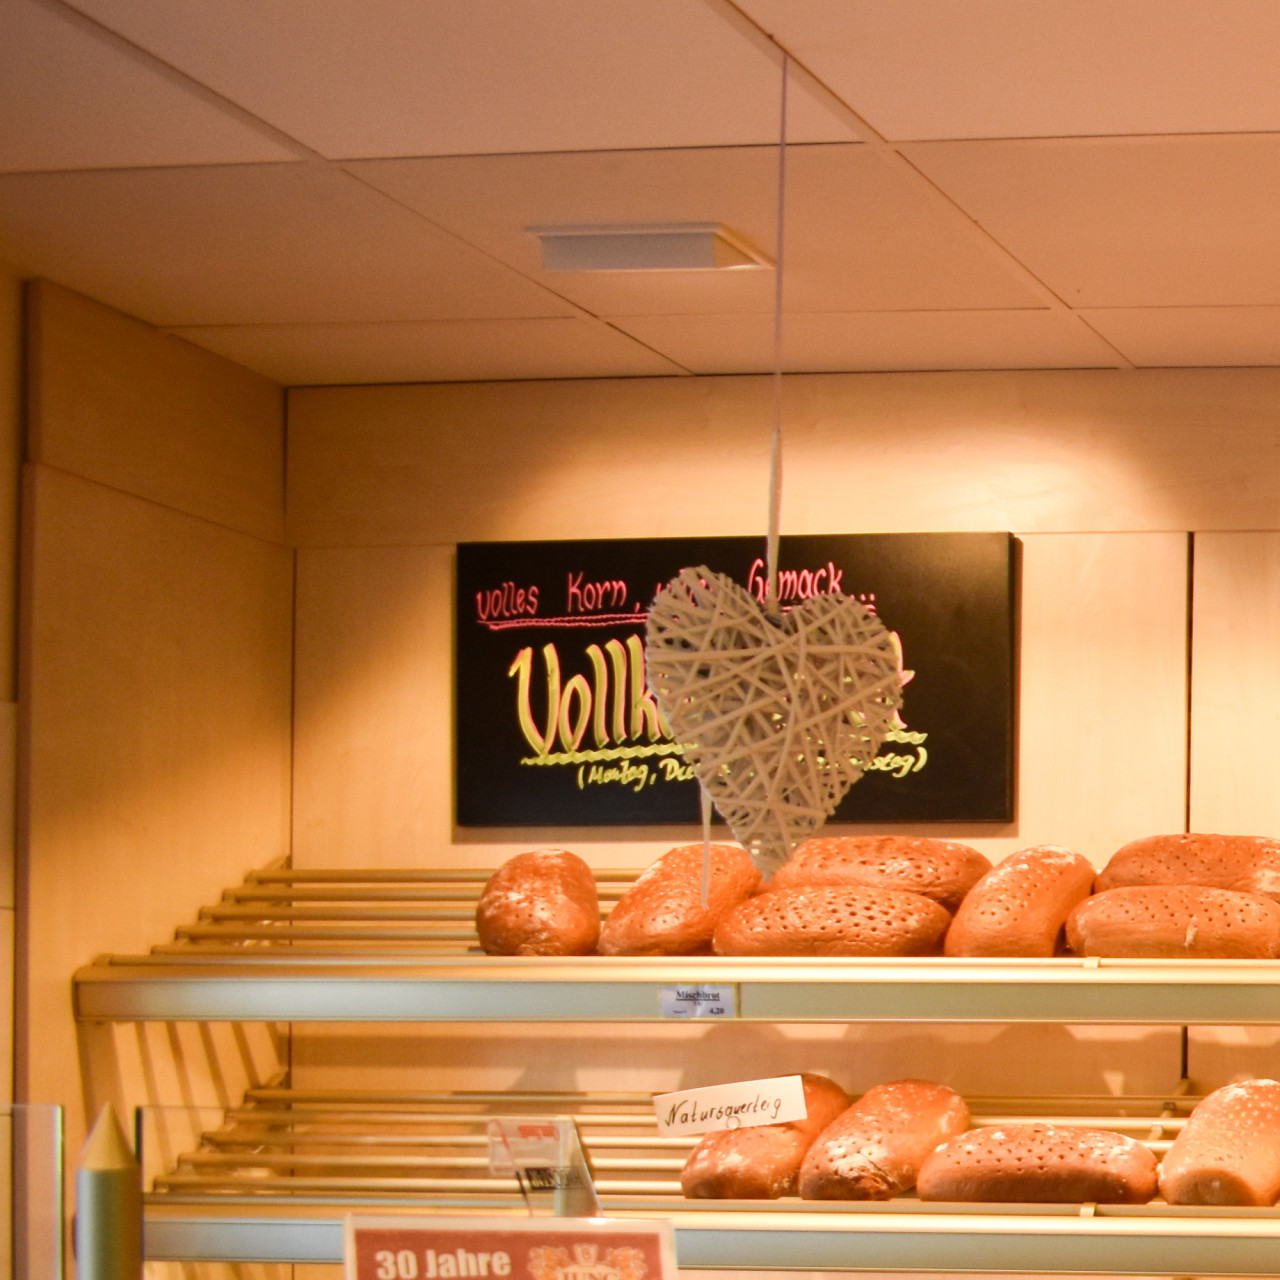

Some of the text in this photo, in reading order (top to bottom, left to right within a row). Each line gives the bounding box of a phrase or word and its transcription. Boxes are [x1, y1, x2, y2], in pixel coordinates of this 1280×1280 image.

[664, 1094, 782, 1127] Natursauerteig
[375, 1248, 512, 1280] 30 Jahre
